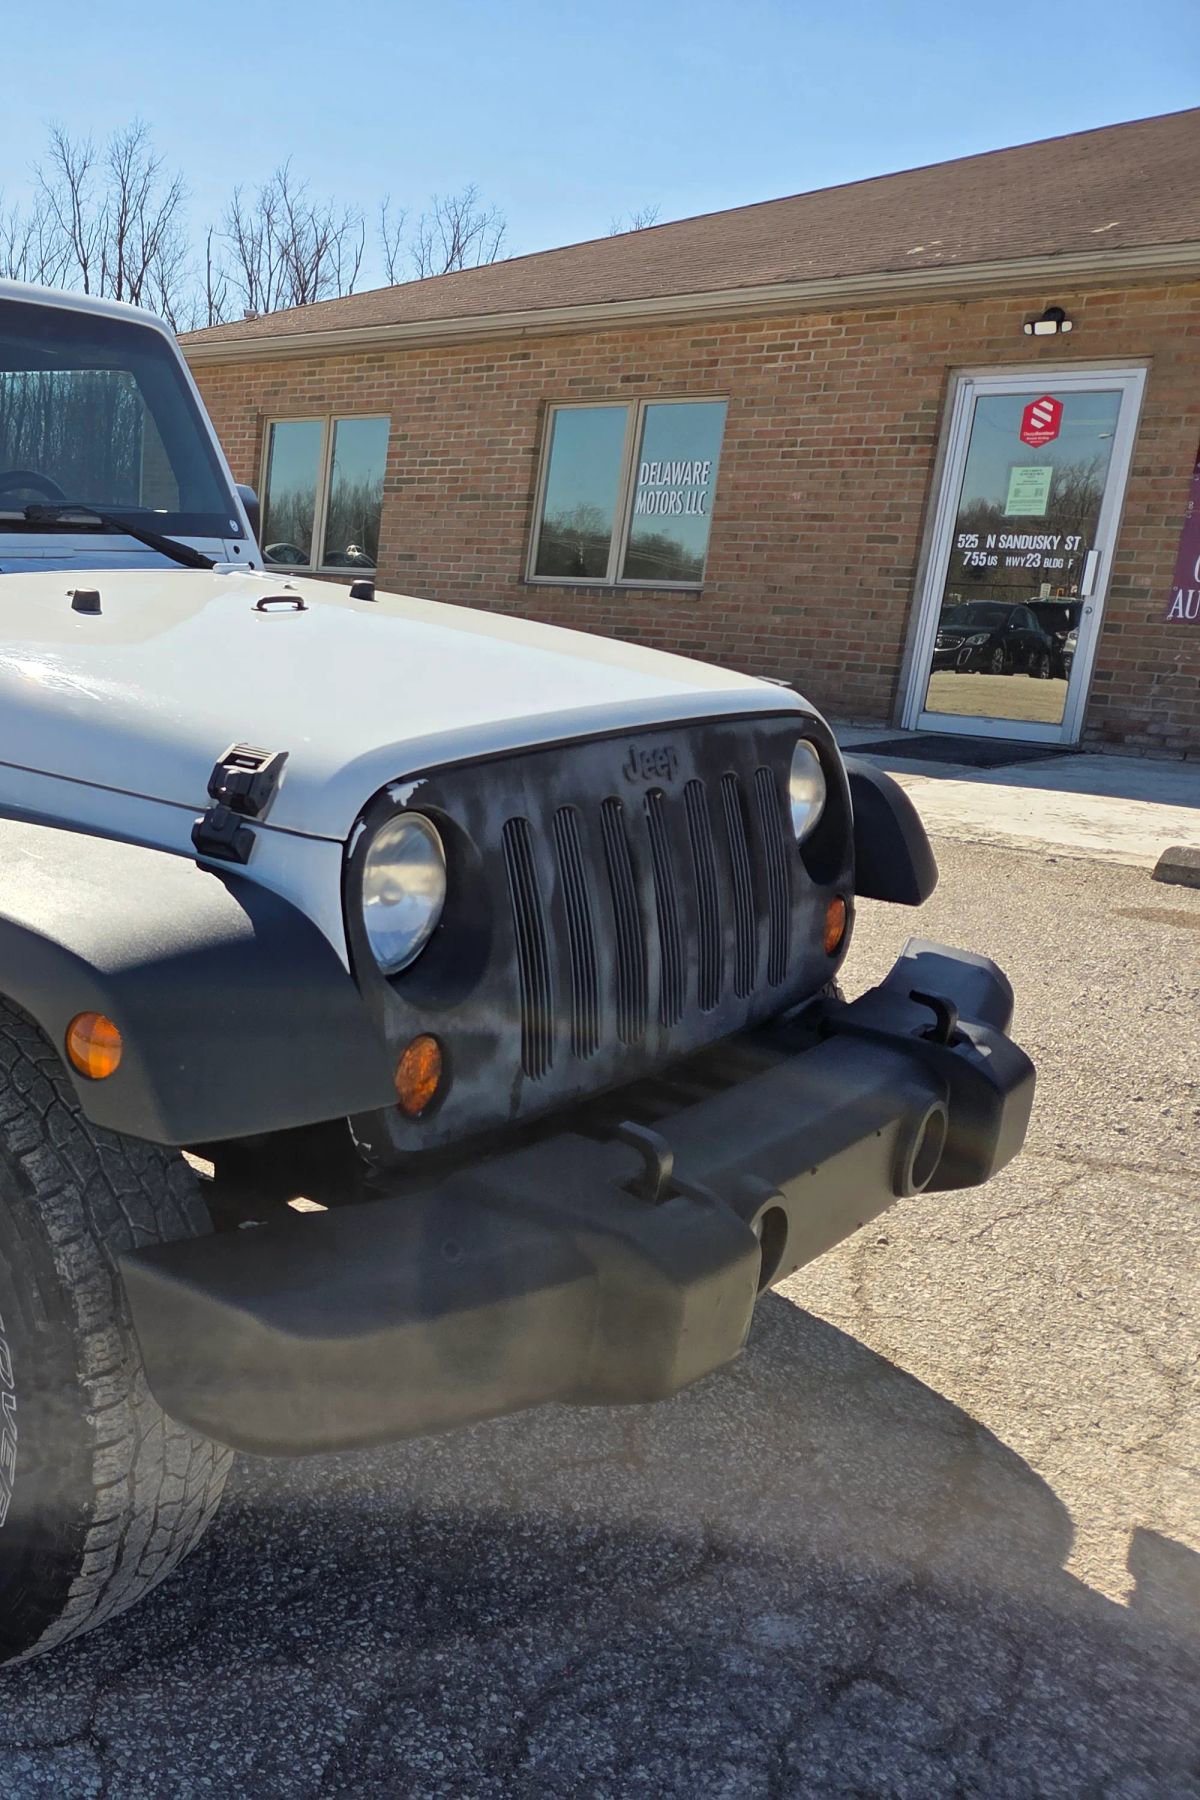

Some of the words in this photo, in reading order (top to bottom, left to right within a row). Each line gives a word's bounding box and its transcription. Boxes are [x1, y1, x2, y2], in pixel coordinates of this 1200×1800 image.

[639, 461, 711, 486] DELAWARE
[635, 491, 683, 515] MOTORS
[686, 491, 708, 515] LLC
[957, 534, 979, 549] 525
[986, 534, 997, 549] N
[998, 534, 1061, 550] SANDUSKY
[1065, 536, 1081, 551] ST
[963, 551, 987, 566] 755
[987, 555, 998, 566] US
[1005, 556, 1026, 567] HWY
[1025, 553, 1041, 568] 23
[1043, 557, 1063, 569] BLDG
[1067, 558, 1074, 569] F
[622, 744, 678, 783] Jeep
